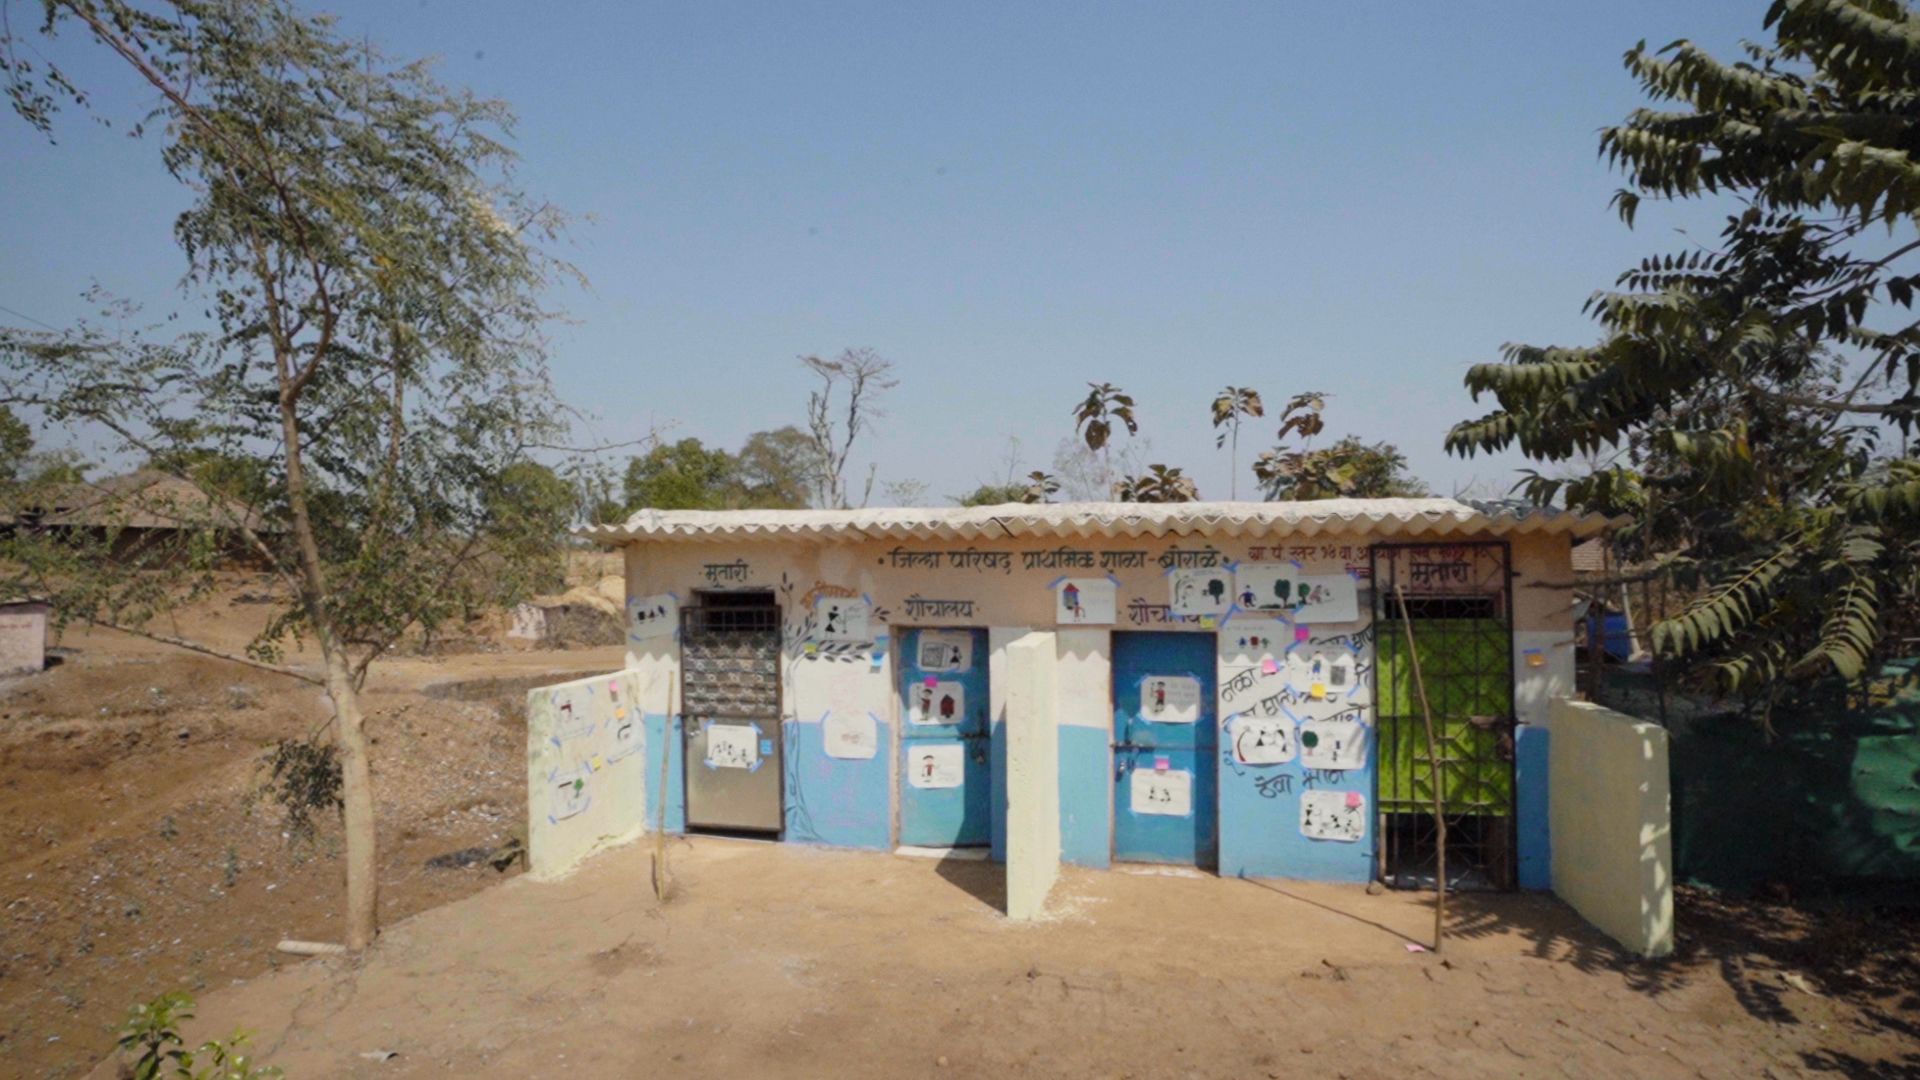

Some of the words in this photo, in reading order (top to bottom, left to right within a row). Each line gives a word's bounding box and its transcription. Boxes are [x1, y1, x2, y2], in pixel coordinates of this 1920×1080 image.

[1021, 545, 1094, 570] प्राथमिक
[1220, 667, 1259, 702] नका
[1254, 774, 1294, 798] ठेवा
